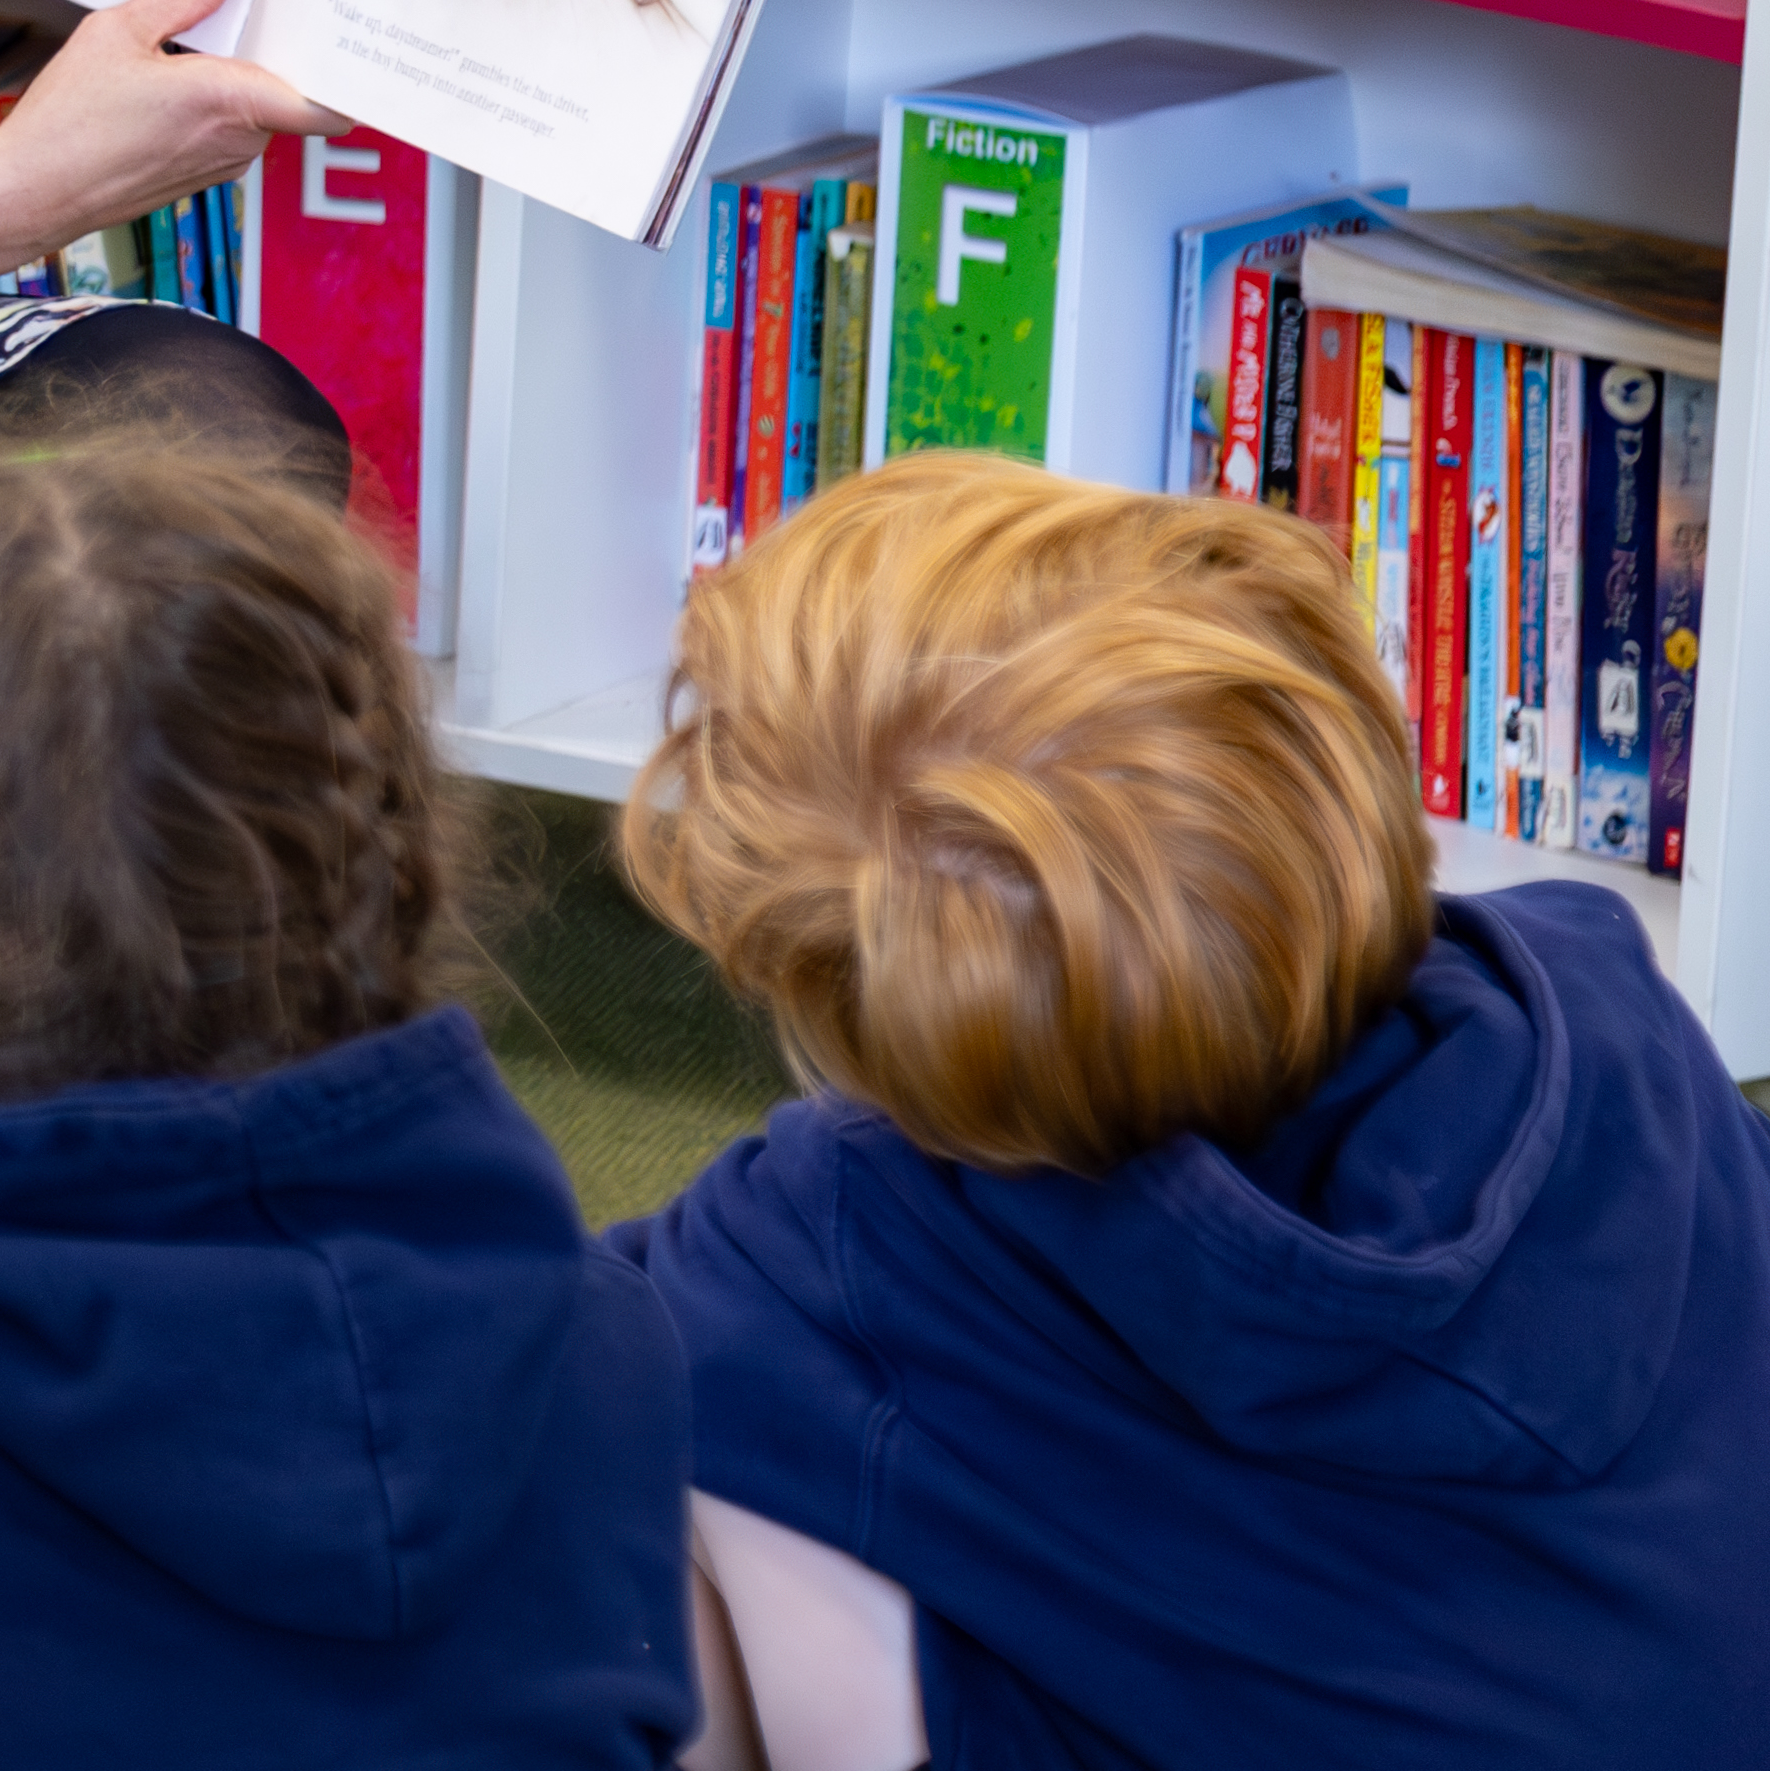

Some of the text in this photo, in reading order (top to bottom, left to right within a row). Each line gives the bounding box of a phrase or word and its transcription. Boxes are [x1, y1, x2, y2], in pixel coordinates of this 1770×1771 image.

[349, 39, 371, 60] the
[371, 48, 392, 72] boy
[393, 58, 433, 88] bumps
[432, 75, 457, 96] into
[455, 86, 502, 117] another
[458, 56, 591, 124] grumbles the bus driver,
[925, 115, 1040, 168] Fiction
[301, 134, 388, 226] E
[936, 183, 1018, 308] F
[1270, 297, 1302, 473] CATHERINE FISHER
[1438, 496, 1458, 553] STEAM
[1435, 559, 1456, 629] WHISTLE
